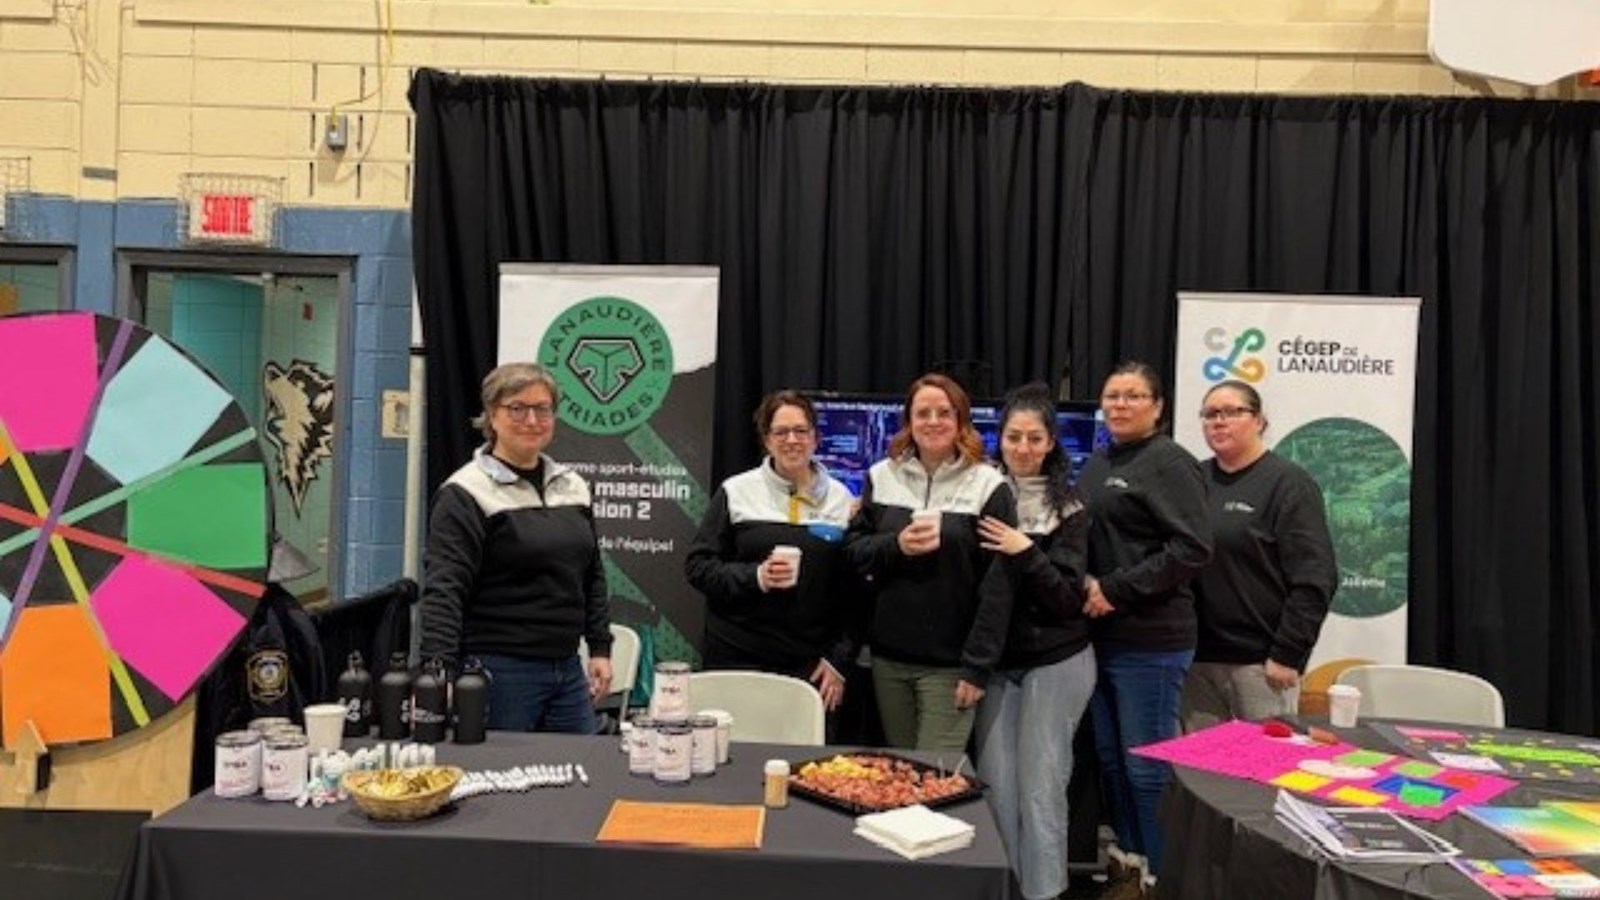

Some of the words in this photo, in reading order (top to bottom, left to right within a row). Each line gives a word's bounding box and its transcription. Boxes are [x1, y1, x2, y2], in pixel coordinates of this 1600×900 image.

[202, 194, 253, 234] SORTIE
[546, 304, 666, 372] LANAUDIÈRE
[1278, 335, 1341, 356] CÉGEP
[1277, 354, 1395, 375] LANAUDIÈRE
[559, 391, 654, 427] TRIADES
[595, 480, 691, 499] masculin
[637, 501, 651, 520] 2
